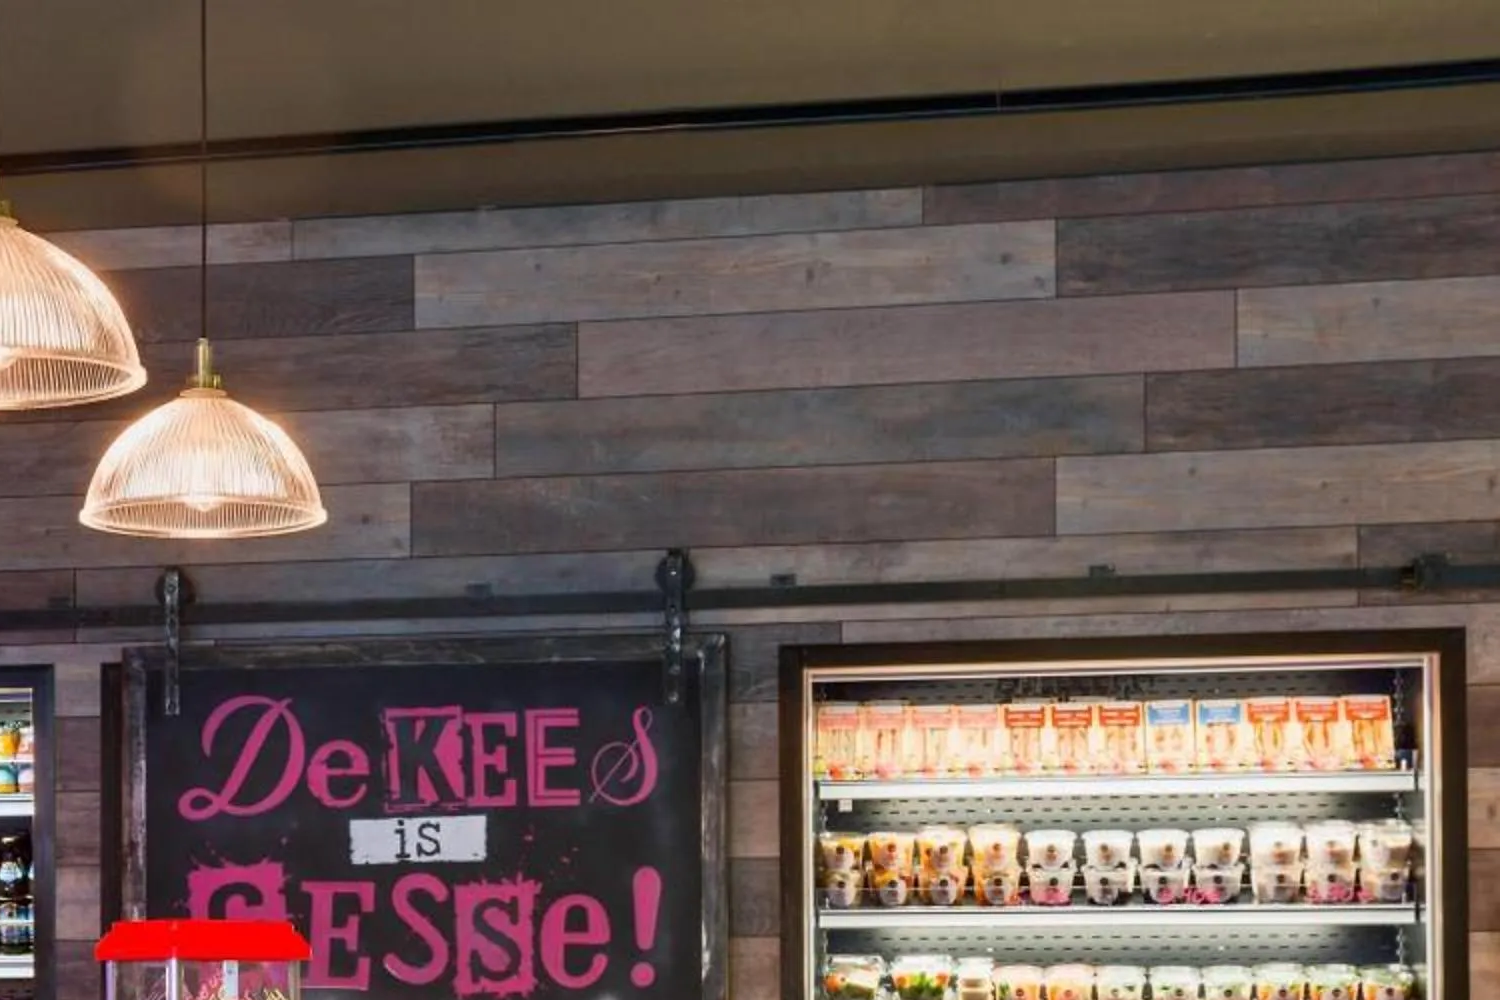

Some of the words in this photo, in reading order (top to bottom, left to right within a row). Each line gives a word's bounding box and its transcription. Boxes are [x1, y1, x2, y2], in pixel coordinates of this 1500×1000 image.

[177, 694, 370, 822] De
[381, 703, 659, 814] KEES
[392, 819, 442, 861] is
